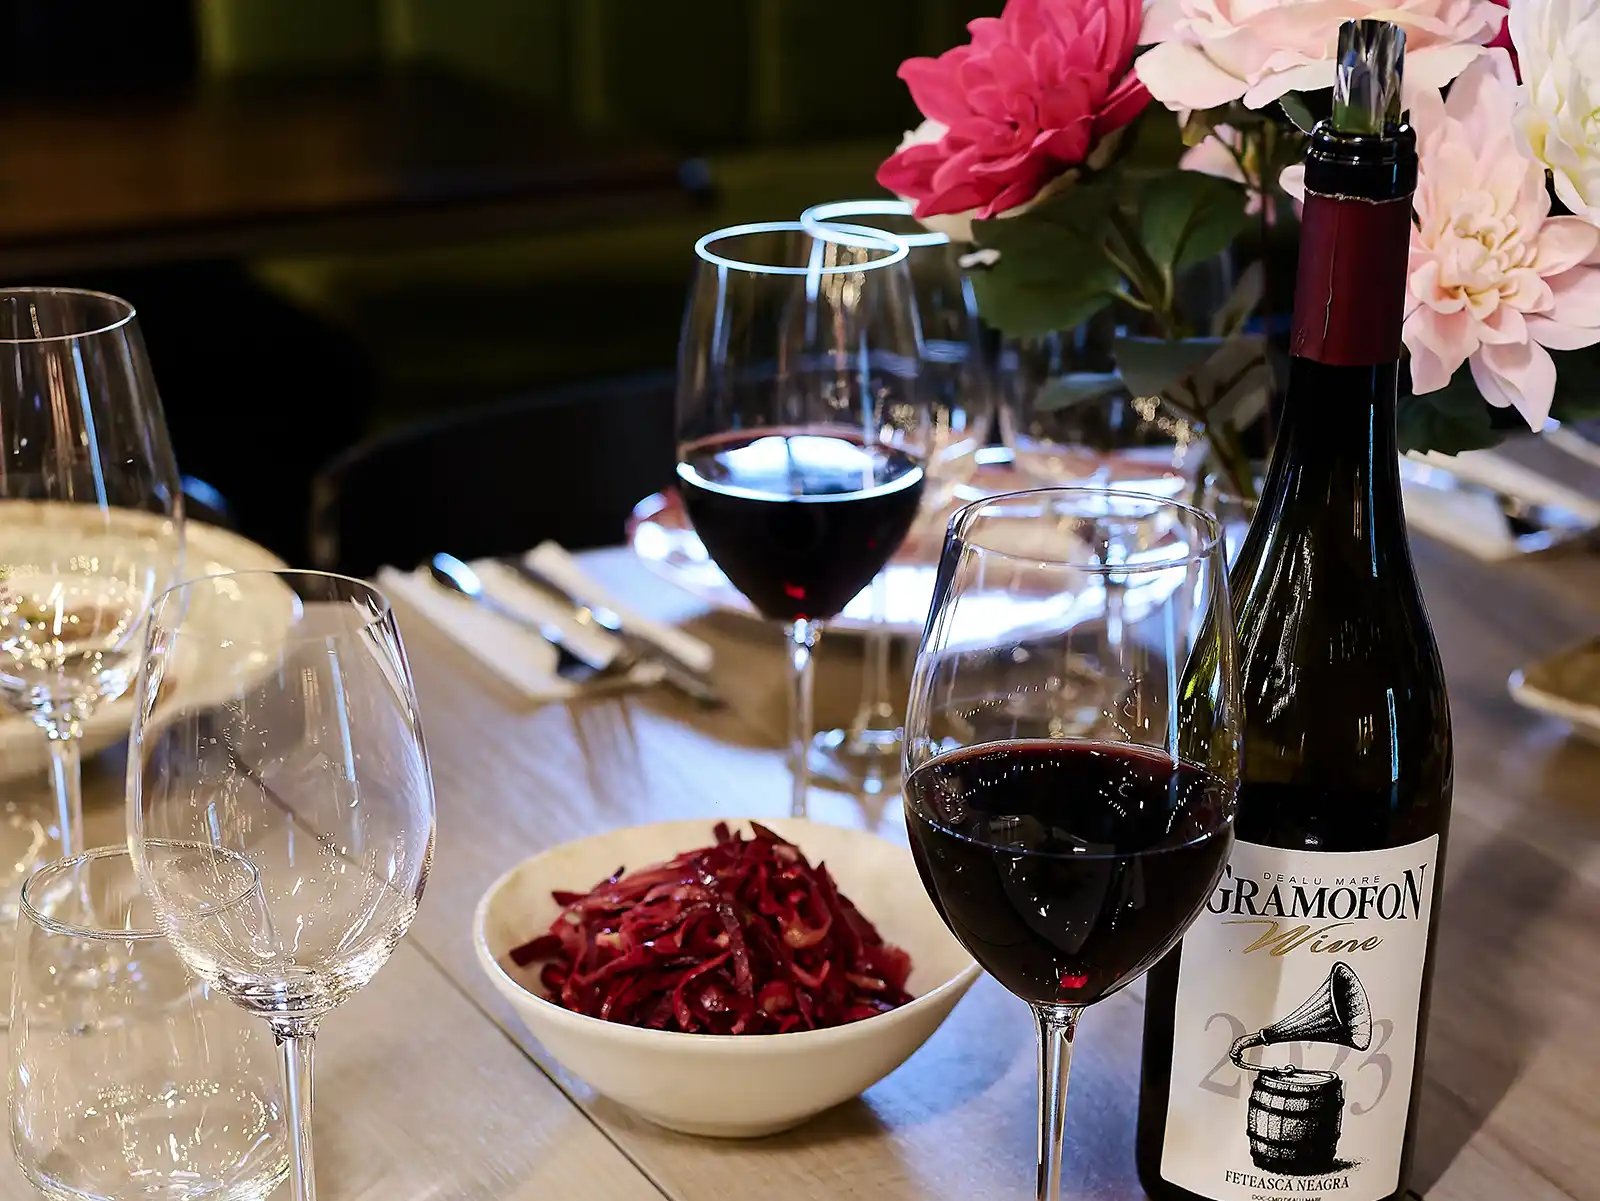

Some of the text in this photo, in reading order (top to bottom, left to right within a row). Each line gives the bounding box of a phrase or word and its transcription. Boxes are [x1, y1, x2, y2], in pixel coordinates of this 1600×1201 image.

[1206, 863, 1427, 920] GRAMOFON
[1262, 872, 1381, 886] DEALU MARE
[1221, 920, 1384, 957] Wine
